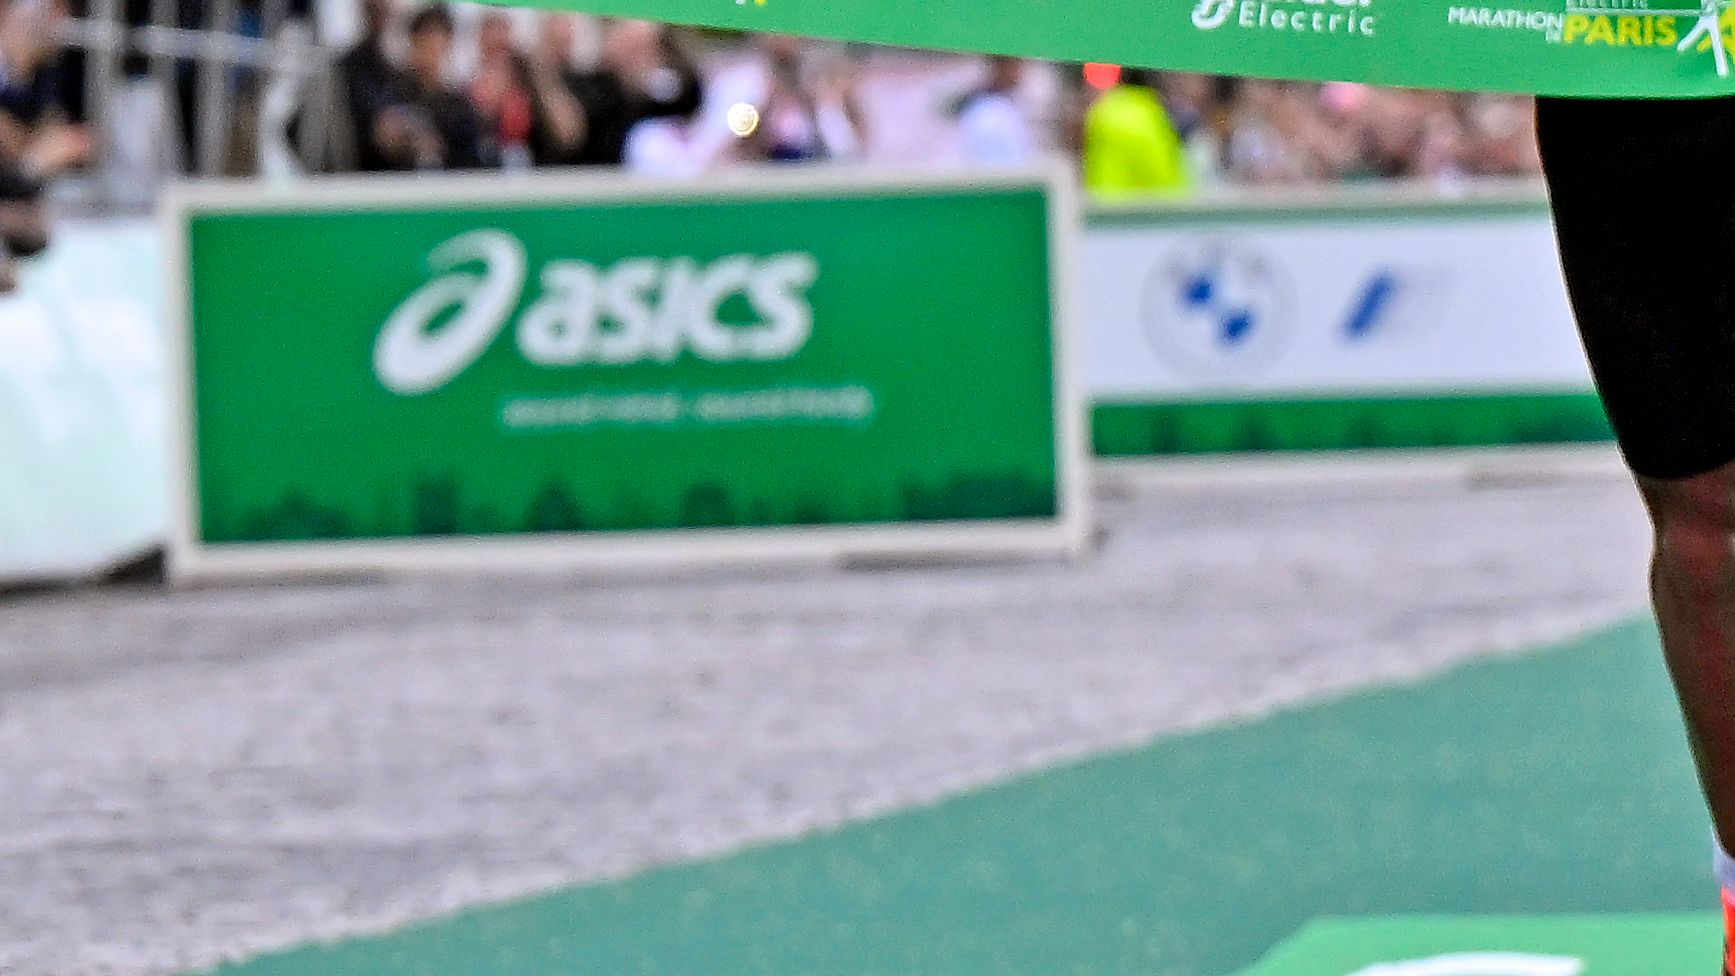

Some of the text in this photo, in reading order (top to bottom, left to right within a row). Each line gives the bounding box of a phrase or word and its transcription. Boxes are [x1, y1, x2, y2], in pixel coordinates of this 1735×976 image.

[1238, 0, 1376, 37] Electric
[1448, 6, 1563, 30] MARATHON
[1564, 15, 1678, 46] PARIS
